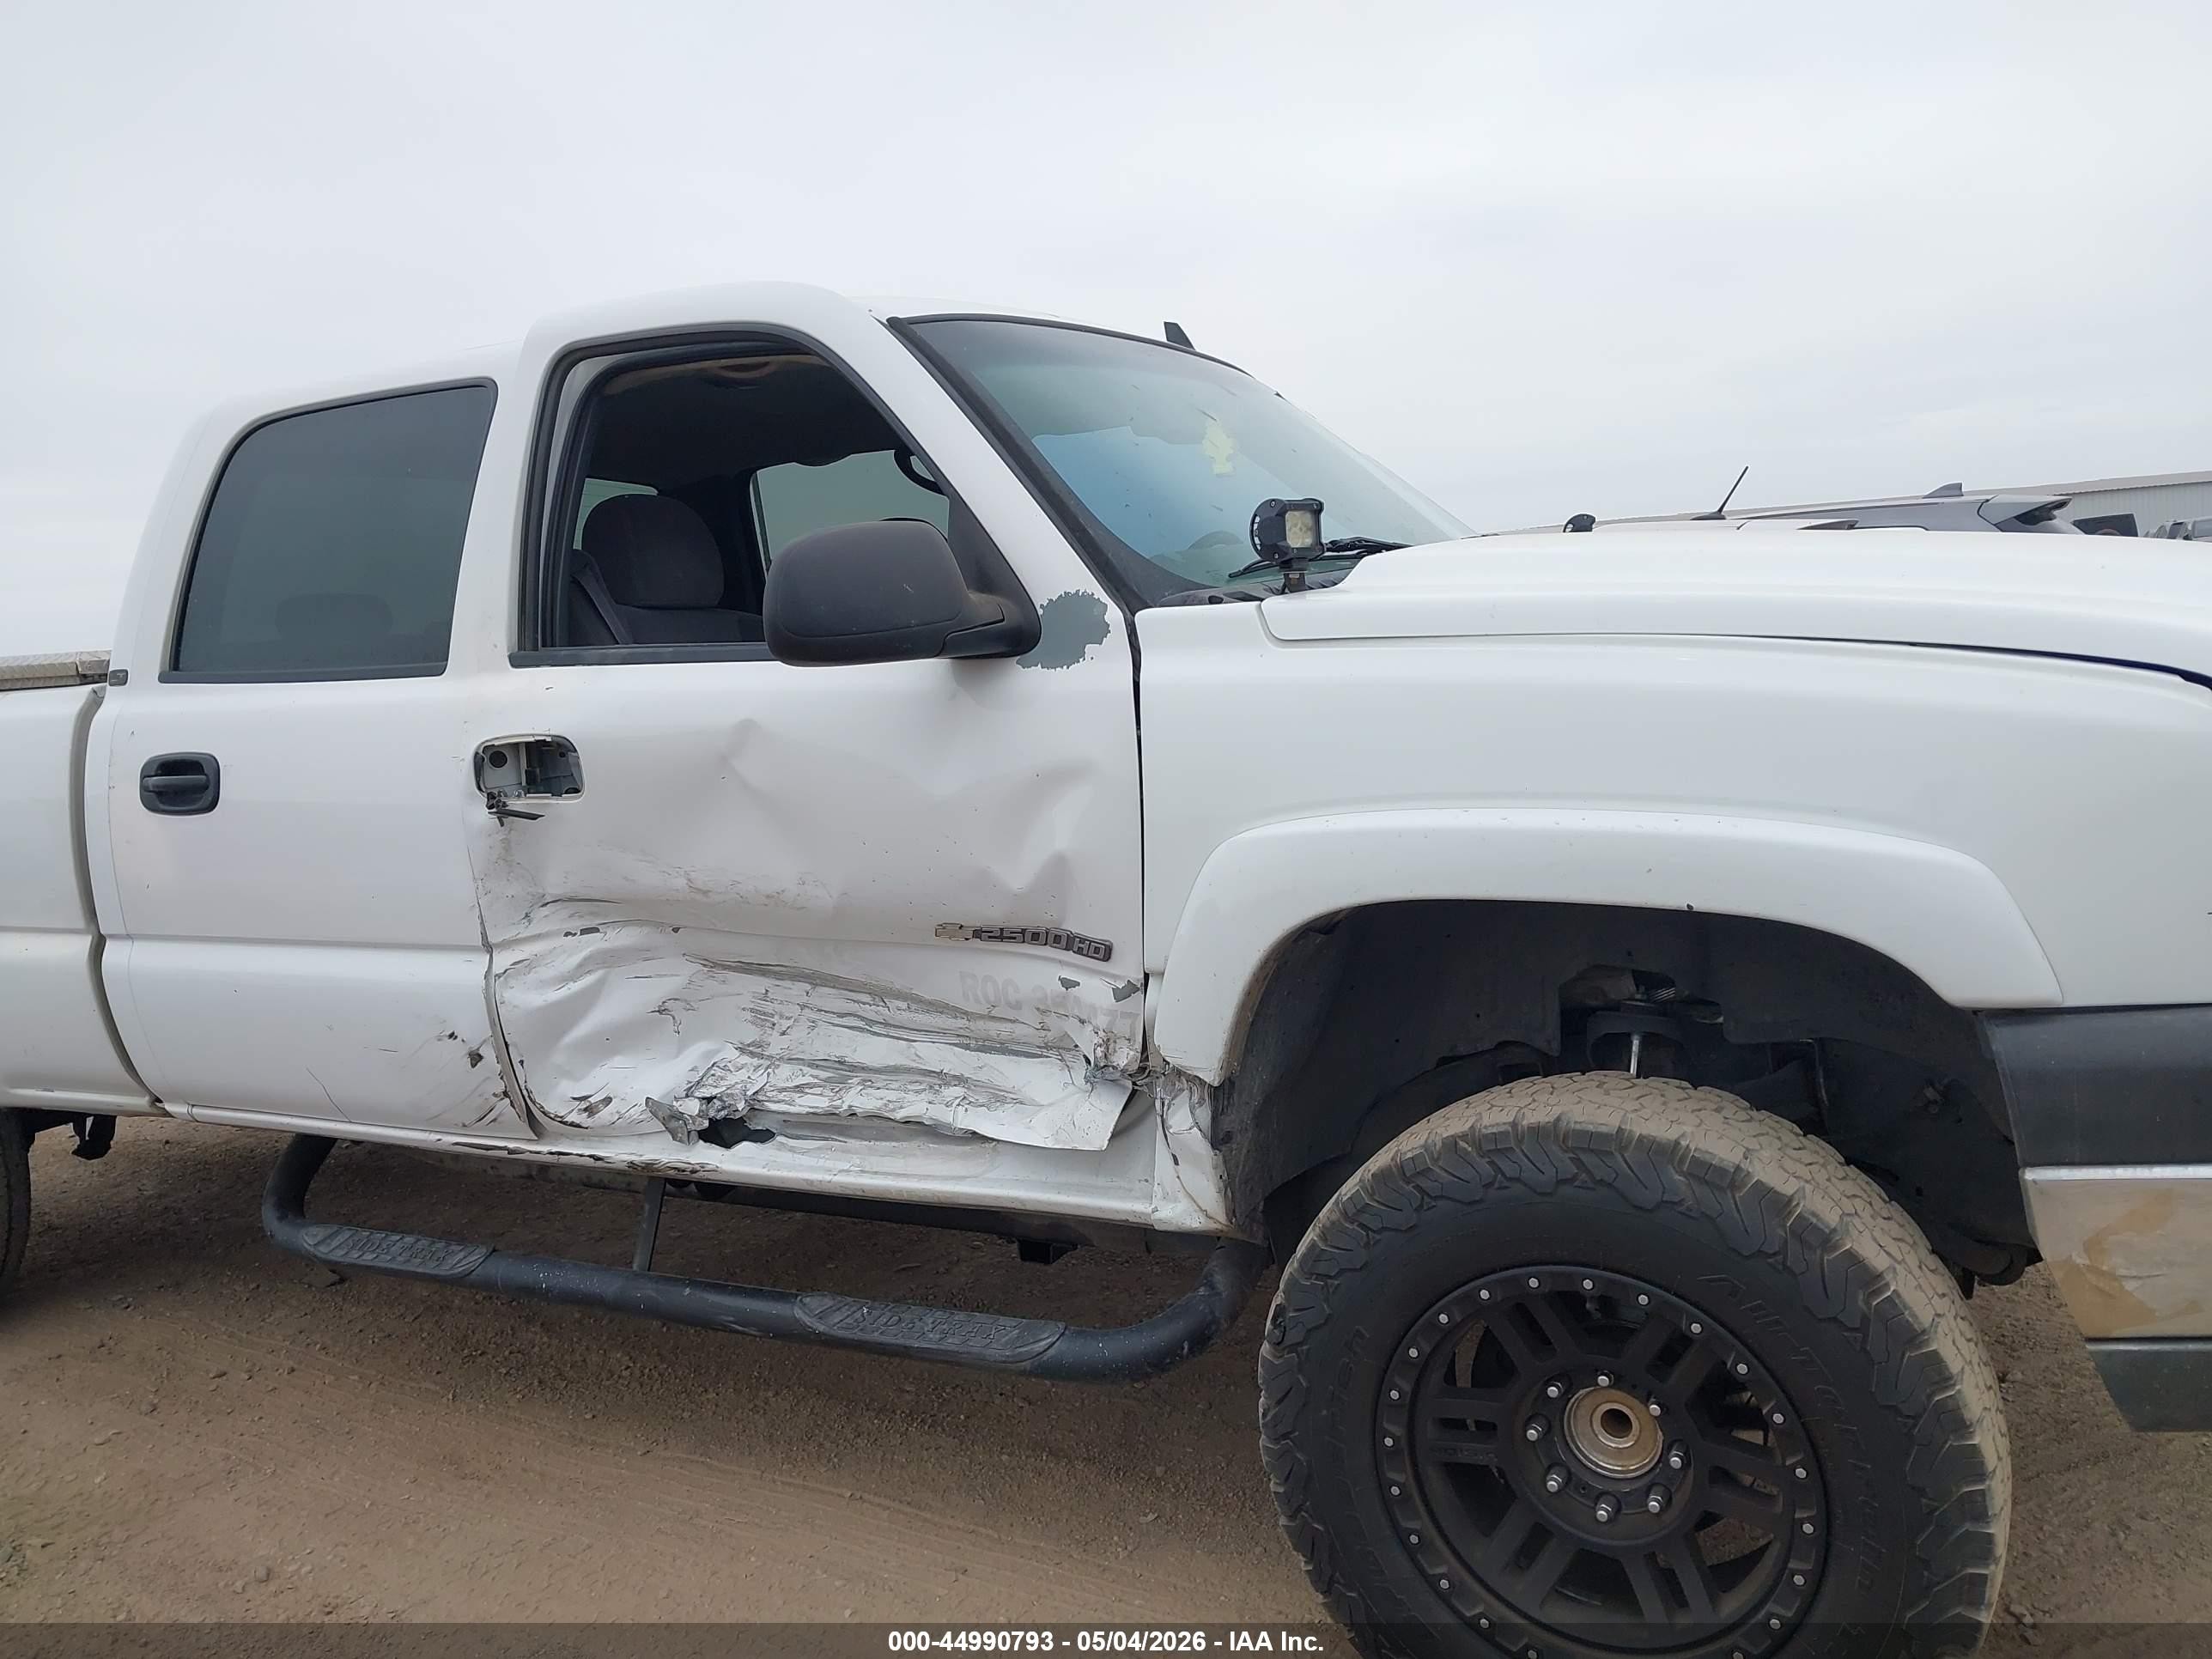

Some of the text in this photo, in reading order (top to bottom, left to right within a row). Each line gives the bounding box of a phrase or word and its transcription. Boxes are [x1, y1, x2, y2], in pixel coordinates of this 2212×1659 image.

[981, 927, 1106, 959] 2500 HD
[958, 970, 1023, 1011] ROC
[854, 1310, 1007, 1340] SIDE TRAX
